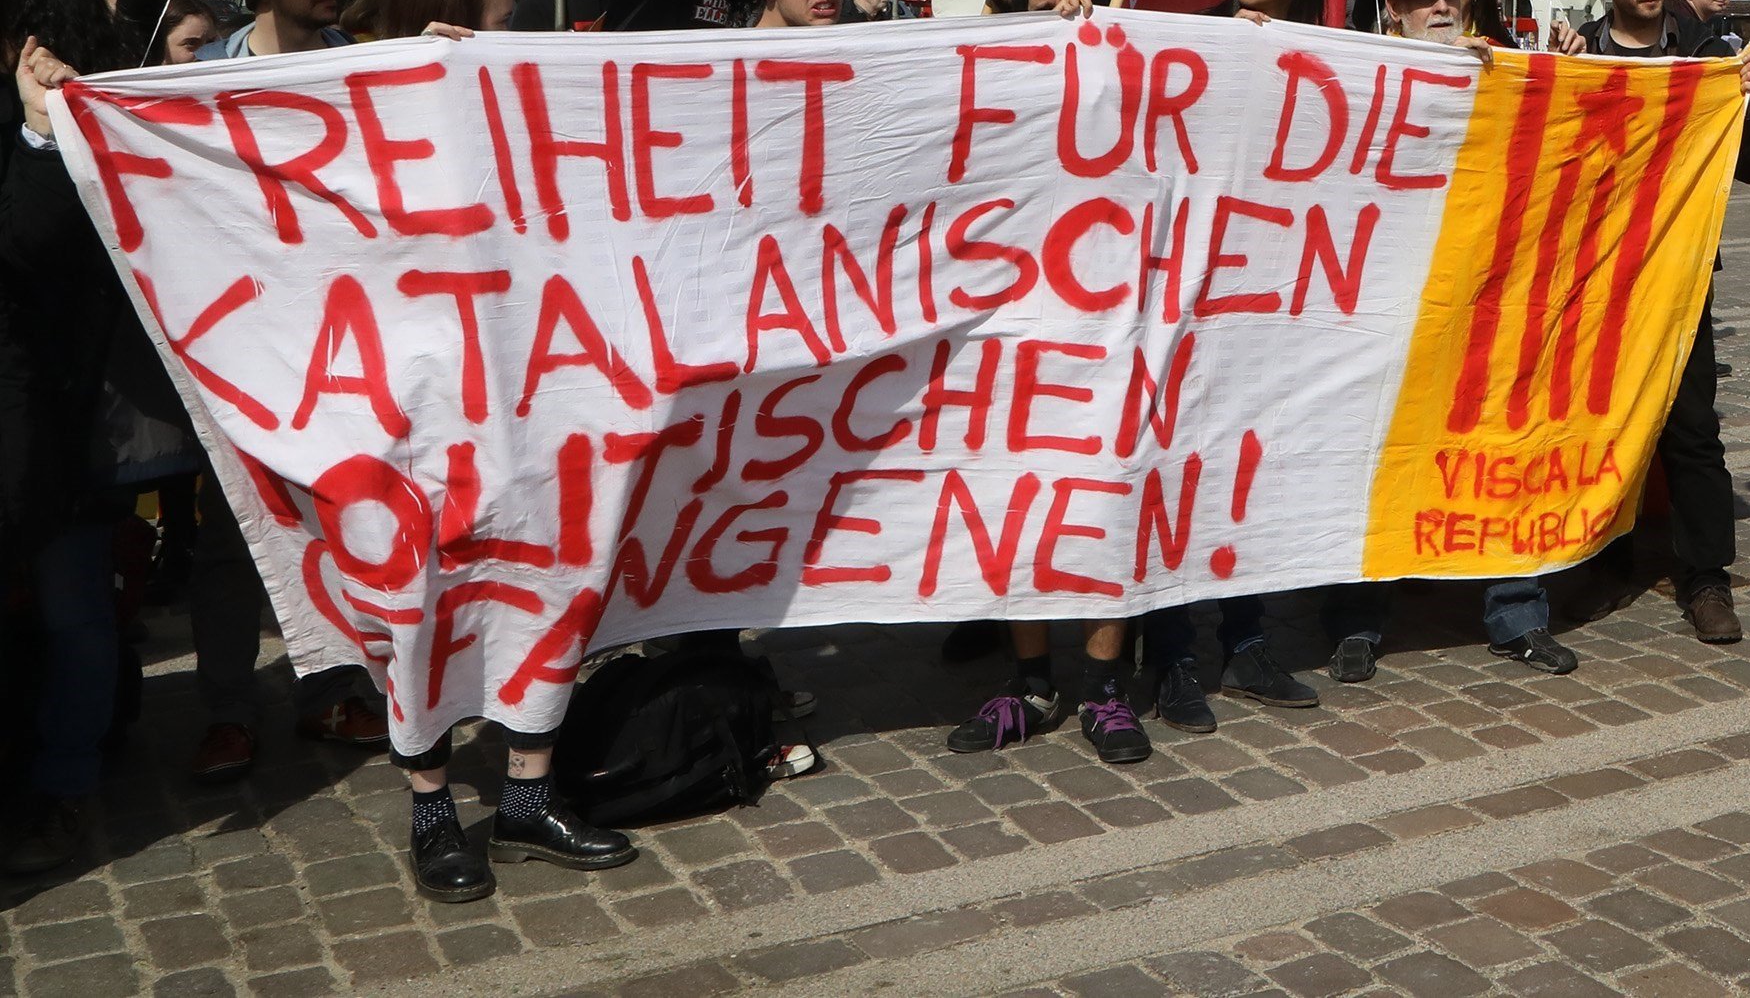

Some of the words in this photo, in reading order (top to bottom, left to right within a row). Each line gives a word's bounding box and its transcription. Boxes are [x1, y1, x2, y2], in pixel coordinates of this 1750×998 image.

[65, 58, 853, 252] FREIHEIT
[948, 20, 1209, 184] FÜR
[1262, 51, 1471, 190] DIE
[133, 197, 1380, 438] KATALANISCHEN
[1435, 446, 1568, 500] VISCA
